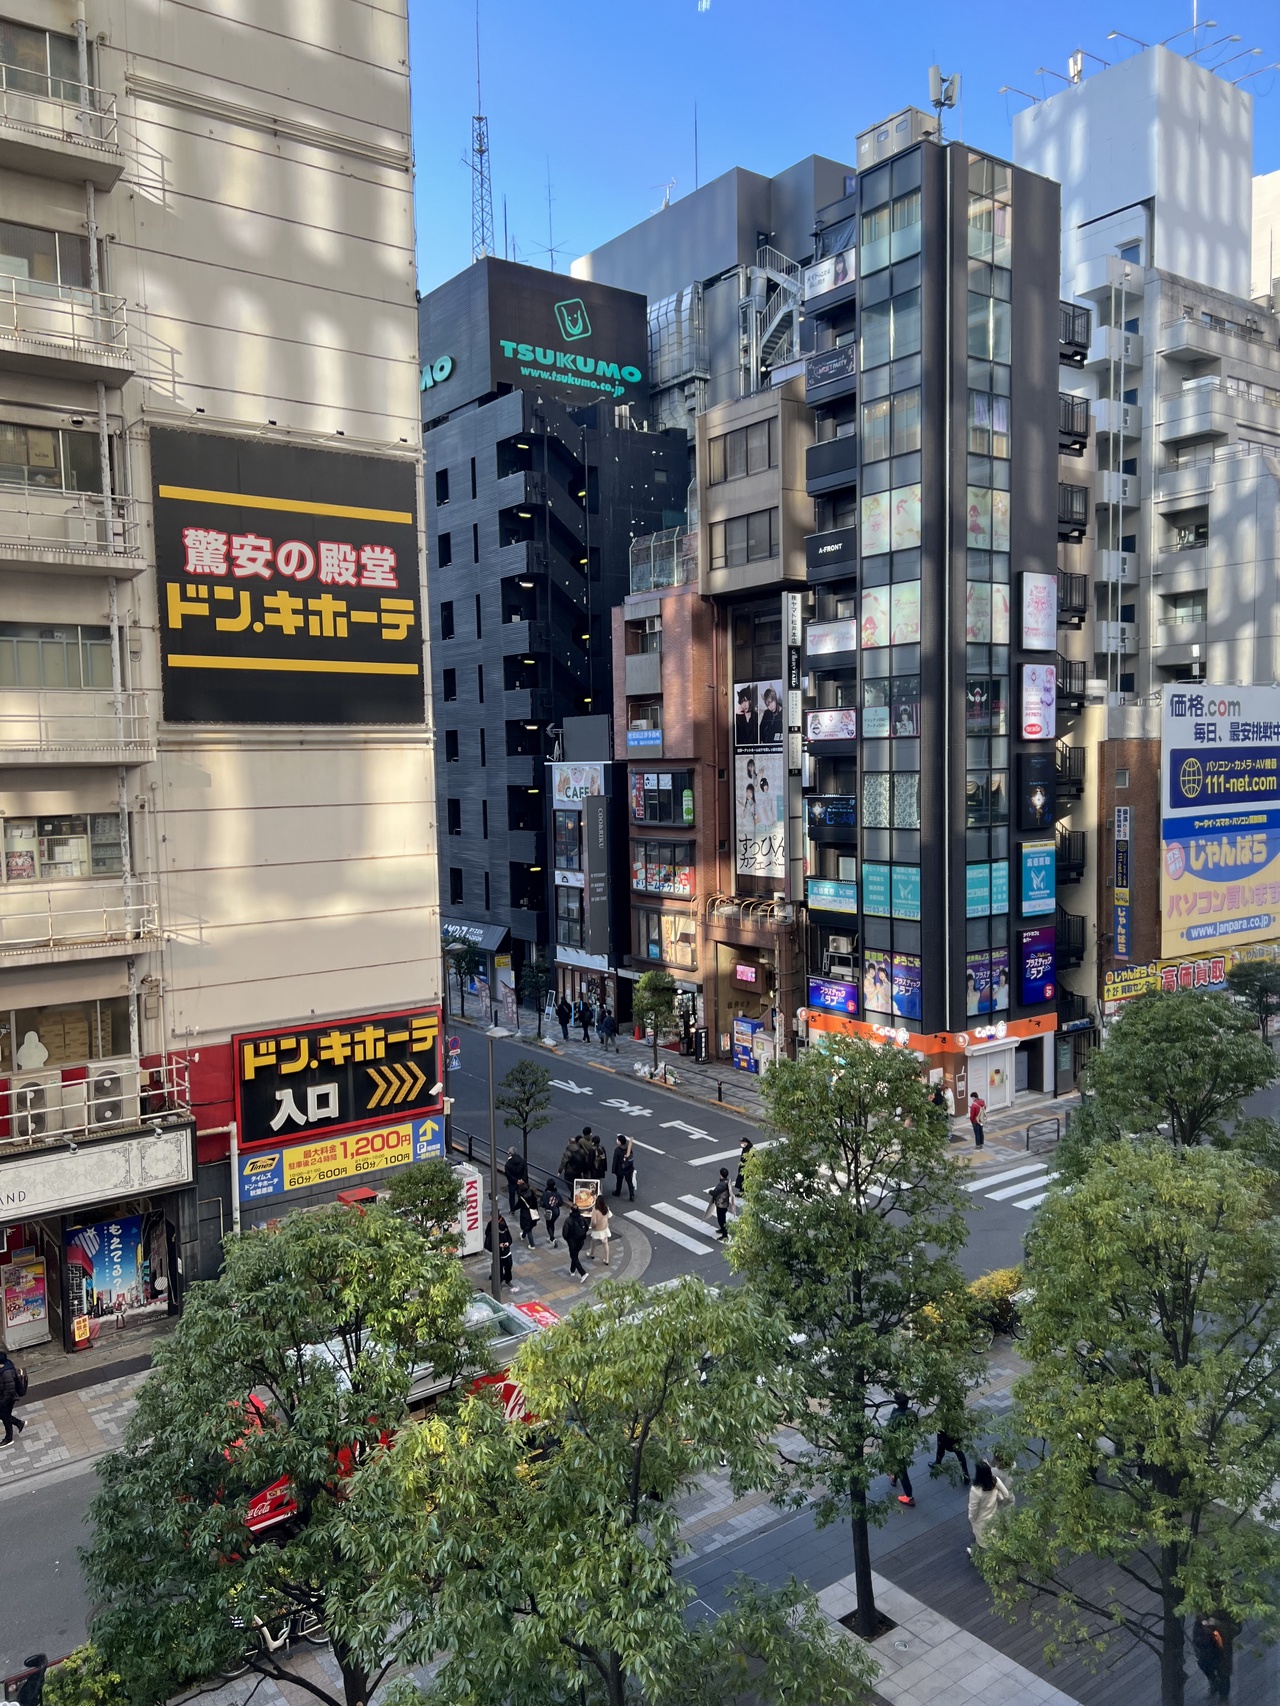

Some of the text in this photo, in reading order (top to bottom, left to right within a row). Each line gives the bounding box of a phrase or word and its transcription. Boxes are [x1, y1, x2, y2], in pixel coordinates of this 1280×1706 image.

[500, 340, 642, 383] TSUKUMO
[520, 365, 625, 397] www.tsukumo.co.jp
[818, 542, 843, 554] A-FRONT
[182, 526, 398, 589] 驚安の殿堂
[1170, 693, 1241, 718] 価格.com
[1206, 775, 1277, 794] 111-net.com
[738, 833, 785, 857] すっぴん
[1189, 833, 1268, 871] じゃんぱら
[738, 854, 785, 871] カフェバー
[635, 880, 687, 894] ドリームチケット
[1167, 880, 1280, 918] パソコン買います
[1190, 914, 1268, 938] www.janpara.co.jp
[893, 955, 921, 967] ようこそ
[1026, 956, 1052, 968] プラスティック
[1030, 966, 1045, 980] ラブ
[1161, 957, 1225, 992] 高価買取
[894, 976, 921, 988] プラスティック
[899, 985, 913, 996] ラブ
[820, 986, 846, 997] プラスティック
[825, 995, 838, 1006] ラブ
[975, 1025, 996, 1039] CoCo
[269, 1081, 340, 1132] 入口
[303, 1145, 337, 1159] 最大料金
[340, 1130, 411, 1159] 1,200円
[248, 1157, 277, 1173] Times
[288, 1153, 338, 1171] 駐車後24時間
[250, 1172, 272, 1183] タイムズ
[465, 1179, 479, 1232] KIRIN
